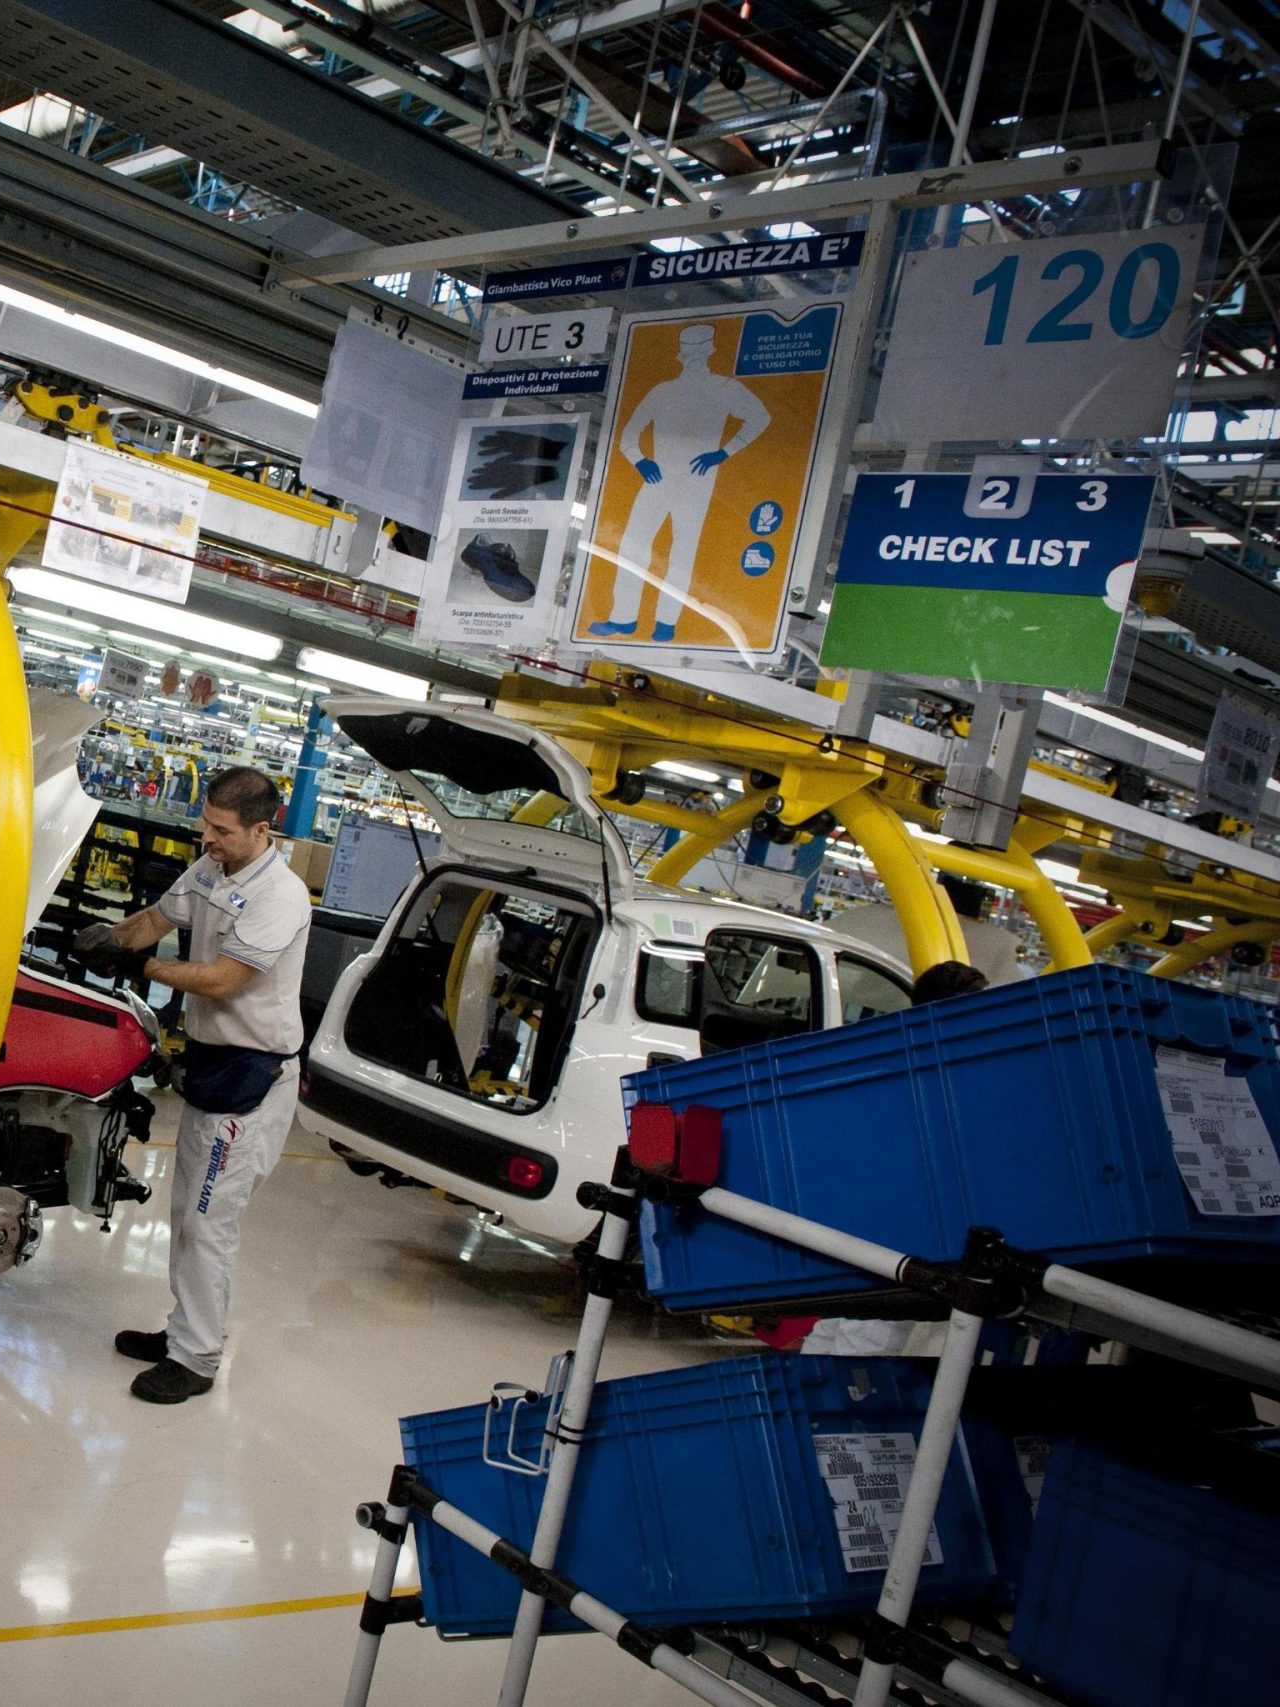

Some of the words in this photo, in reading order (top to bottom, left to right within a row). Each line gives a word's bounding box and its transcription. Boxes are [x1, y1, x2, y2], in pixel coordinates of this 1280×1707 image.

[648, 245, 810, 280] SICUREZZA
[487, 278, 550, 296] Giambattista
[550, 276, 574, 290] Vico
[575, 273, 603, 288] Plant
[971, 240, 1181, 346] 120
[495, 322, 552, 354] UTE
[564, 320, 585, 351] 3
[757, 335, 776, 343] PER
[778, 334, 790, 342] LA
[794, 332, 813, 340] TUA
[757, 341, 810, 352] SICUREZZA
[751, 349, 822, 361] OBBLIGATORIO
[472, 371, 525, 386] Dispositivi
[527, 370, 539, 381] Di
[541, 368, 600, 381] Protezione
[504, 382, 560, 396] Individuali
[893, 479, 916, 509] 1
[978, 480, 1011, 511] 2
[1076, 480, 1109, 512] 3
[480, 507, 501, 515] Guanti
[878, 534, 999, 565] CHECK
[1006, 539, 1091, 568] LIST
[451, 609, 473, 618] Scarpa
[473, 610, 524, 620] antinfortunistica
[1243, 727, 1271, 754] 8010
[197, 1136, 224, 1215] POMIGLIANO
[847, 1500, 858, 1514] 24
